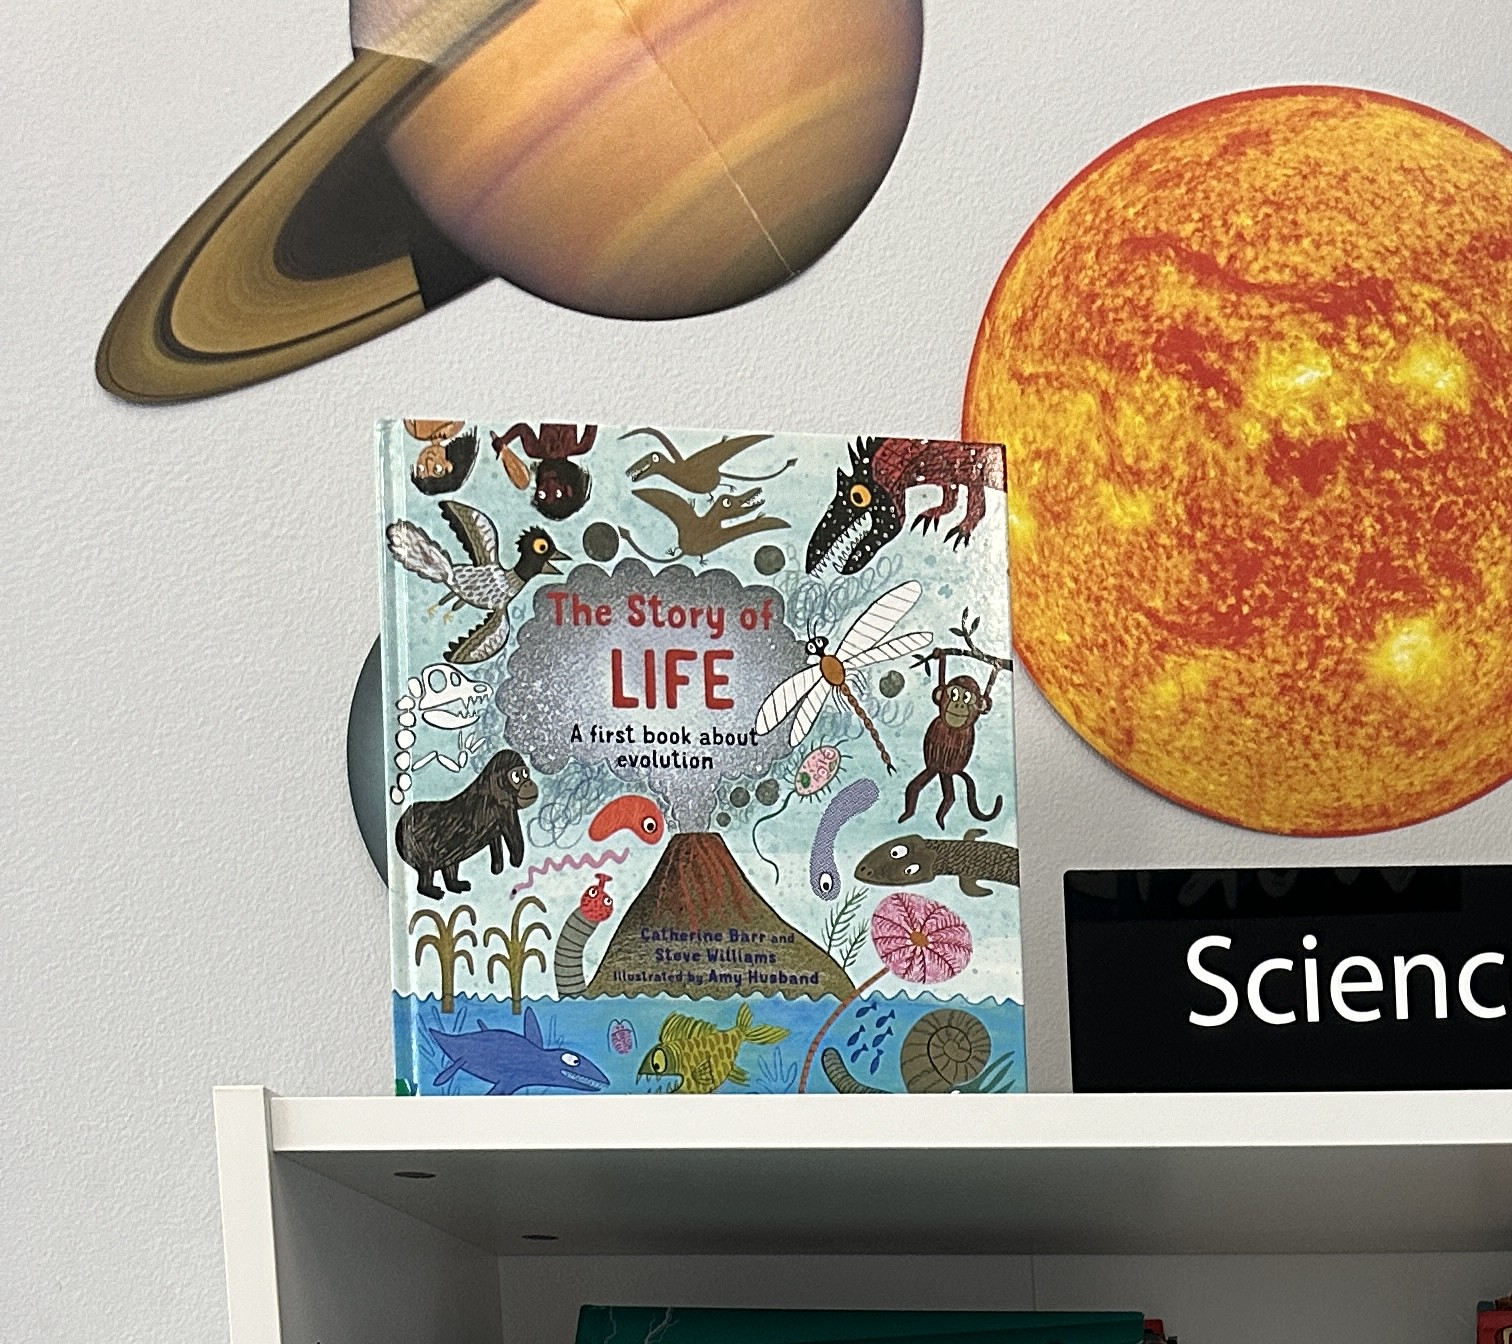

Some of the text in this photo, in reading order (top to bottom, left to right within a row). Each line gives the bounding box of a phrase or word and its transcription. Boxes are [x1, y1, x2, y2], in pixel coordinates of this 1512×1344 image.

[546, 591, 774, 640] The Story of
[610, 648, 735, 710] LIFE
[570, 724, 759, 747] A first book about
[616, 750, 714, 770] evolution
[640, 927, 795, 944] Catherine Barr and
[655, 947, 777, 964] Steve Williams
[613, 969, 820, 988] Illustrated by Amy Husband
